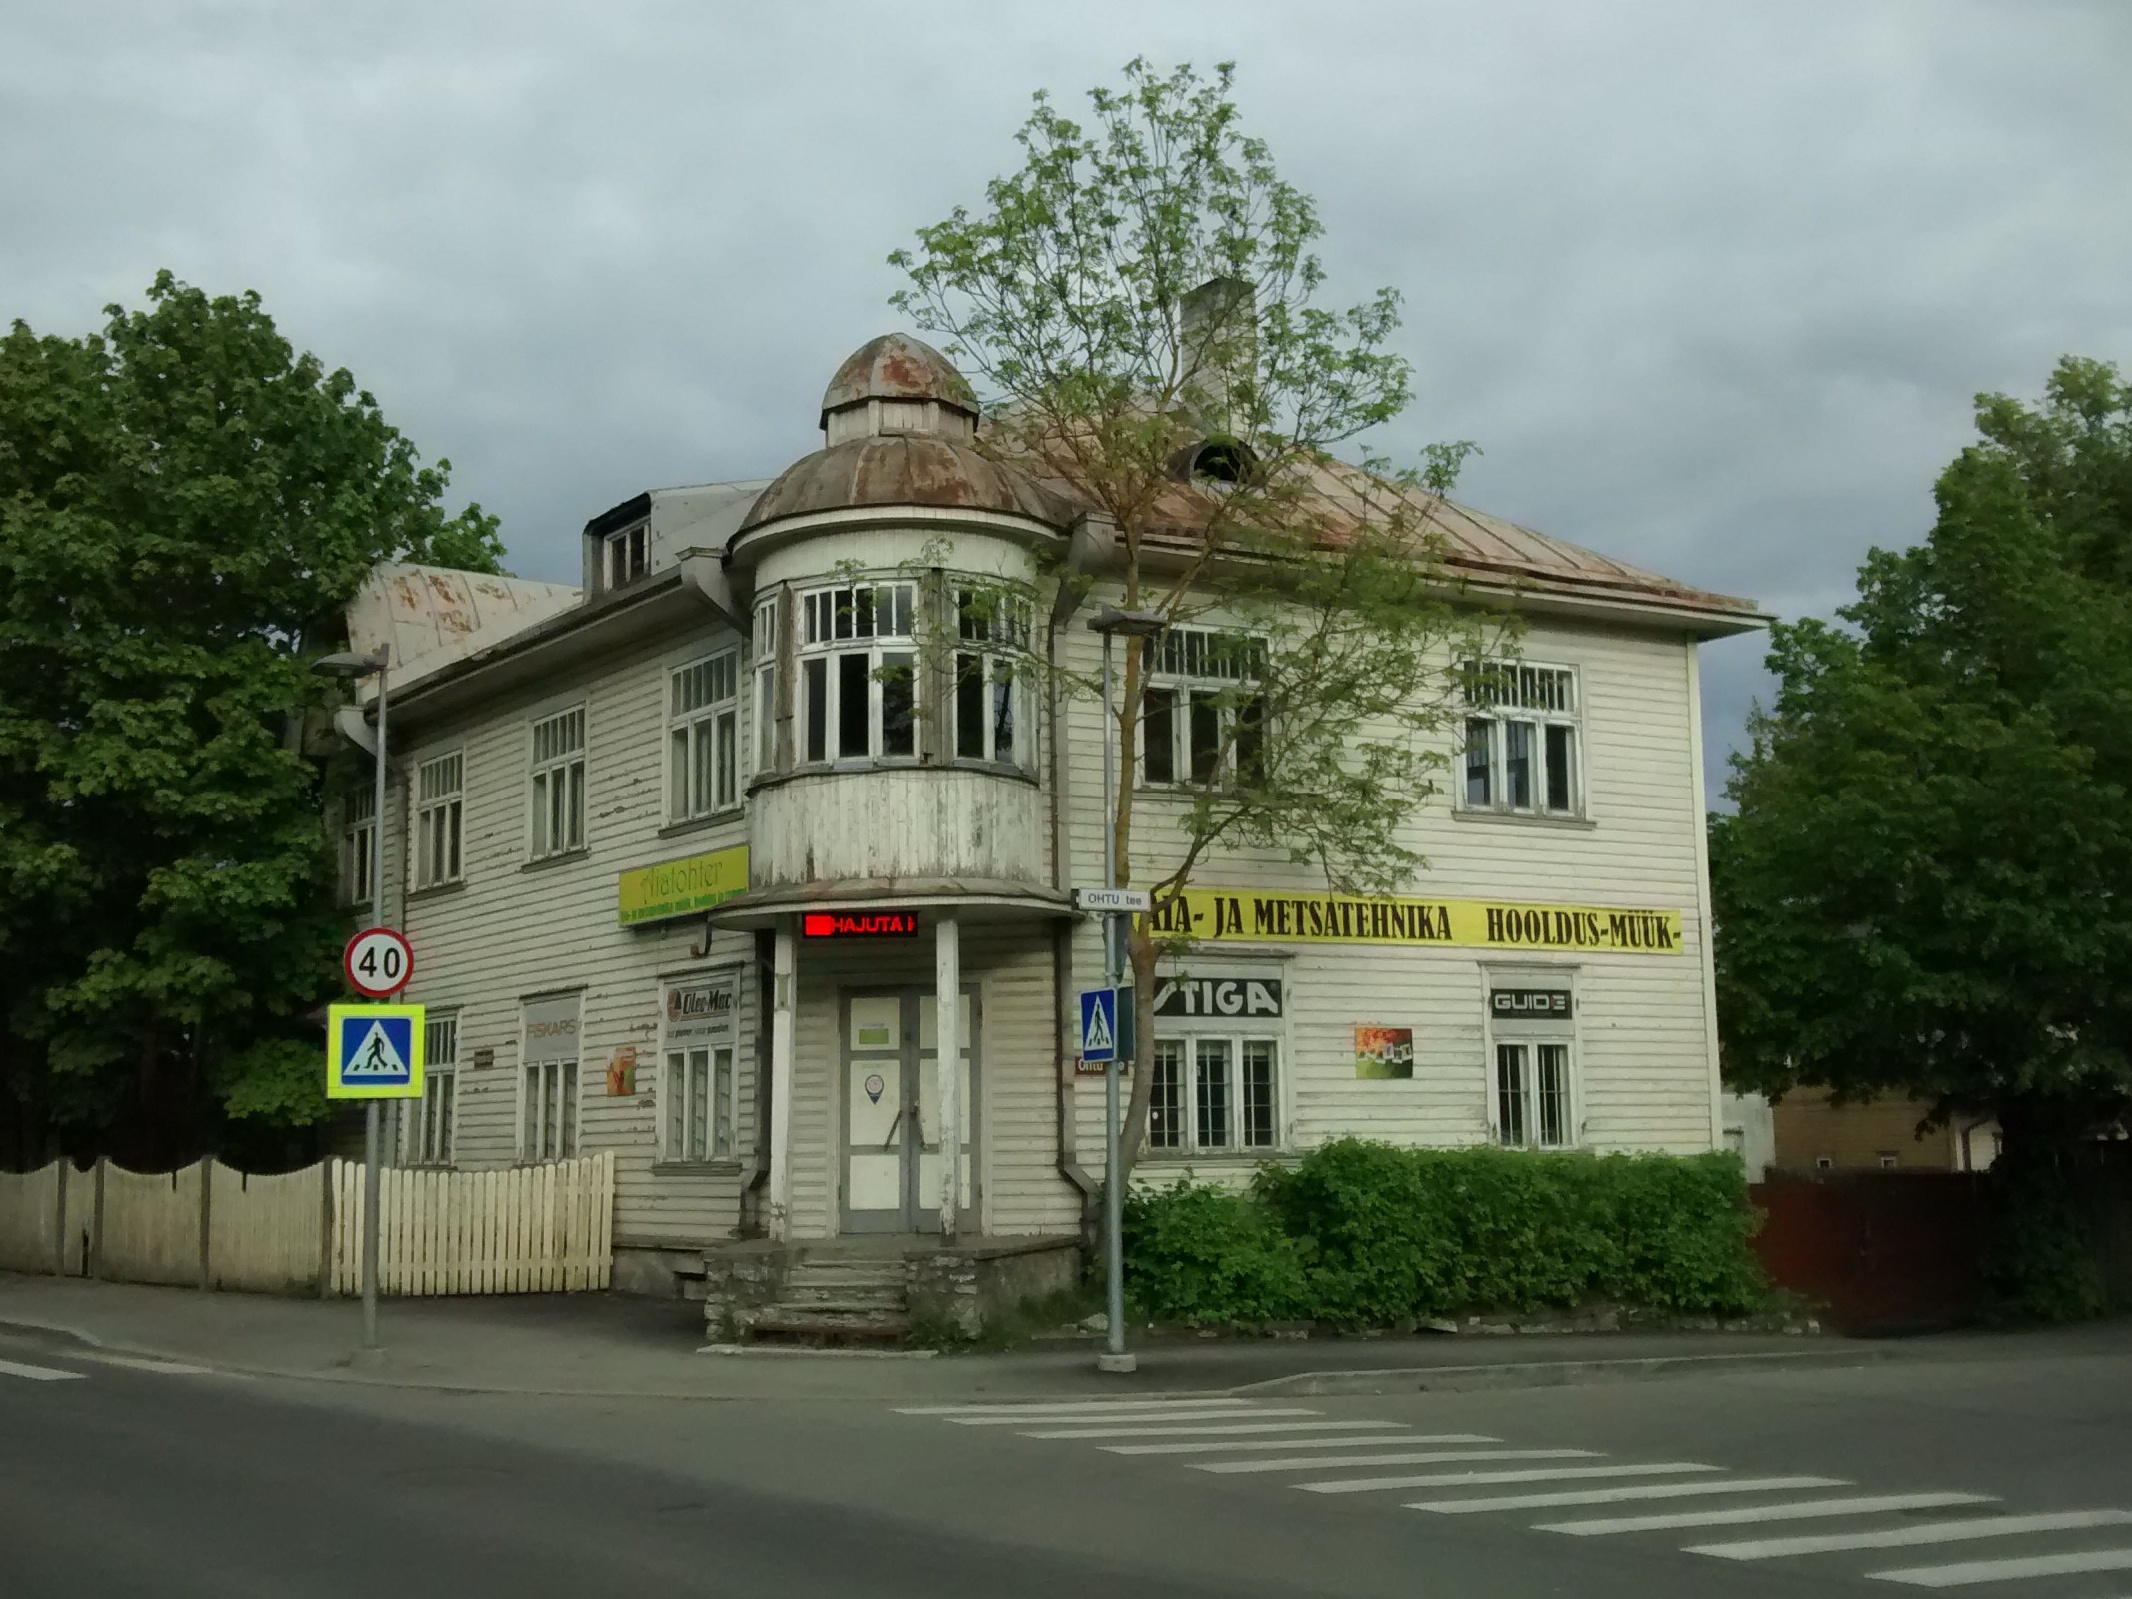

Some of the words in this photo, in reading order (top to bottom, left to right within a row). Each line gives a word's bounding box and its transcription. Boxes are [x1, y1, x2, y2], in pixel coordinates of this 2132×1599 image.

[1088, 893, 1120, 905] OHTU
[1126, 895, 1142, 905] tee
[1213, 897, 1244, 938] JA
[1253, 898, 1453, 940] METSATEHNIKA
[358, 946, 400, 979] 40
[1494, 994, 1566, 1011] GUIDE
[526, 1019, 576, 1039] FISKARS
